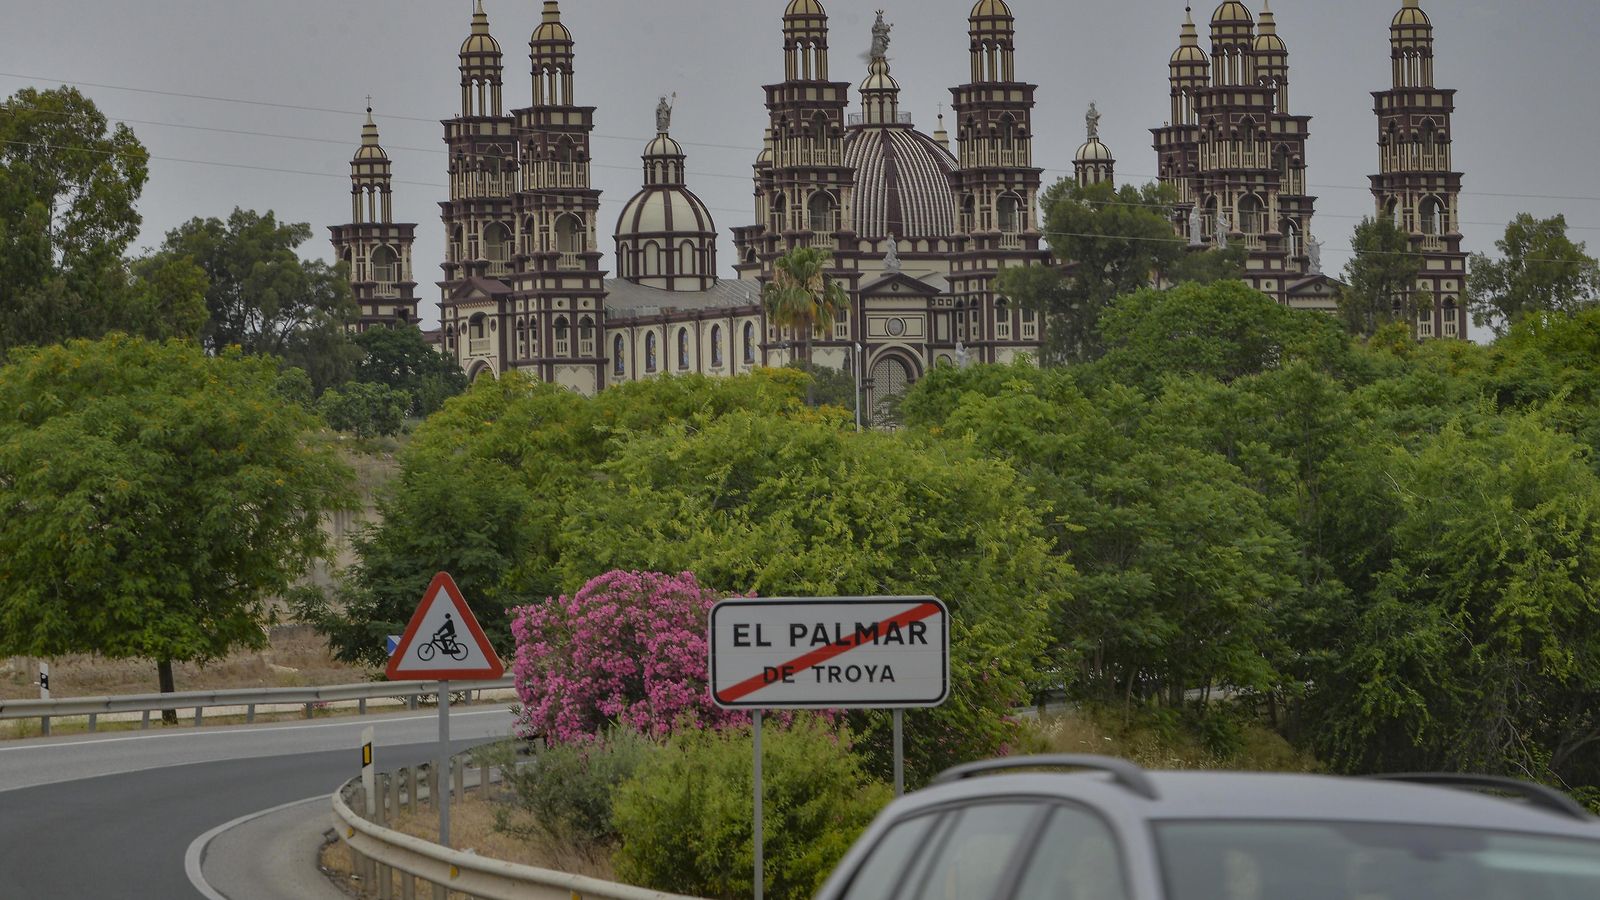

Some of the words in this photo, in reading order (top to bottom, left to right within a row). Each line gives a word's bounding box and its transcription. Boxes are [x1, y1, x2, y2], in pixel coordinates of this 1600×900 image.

[733, 623, 772, 647] EL
[789, 620, 928, 647] PALMAR
[763, 666, 795, 684] DE
[811, 664, 896, 683] TROYA
